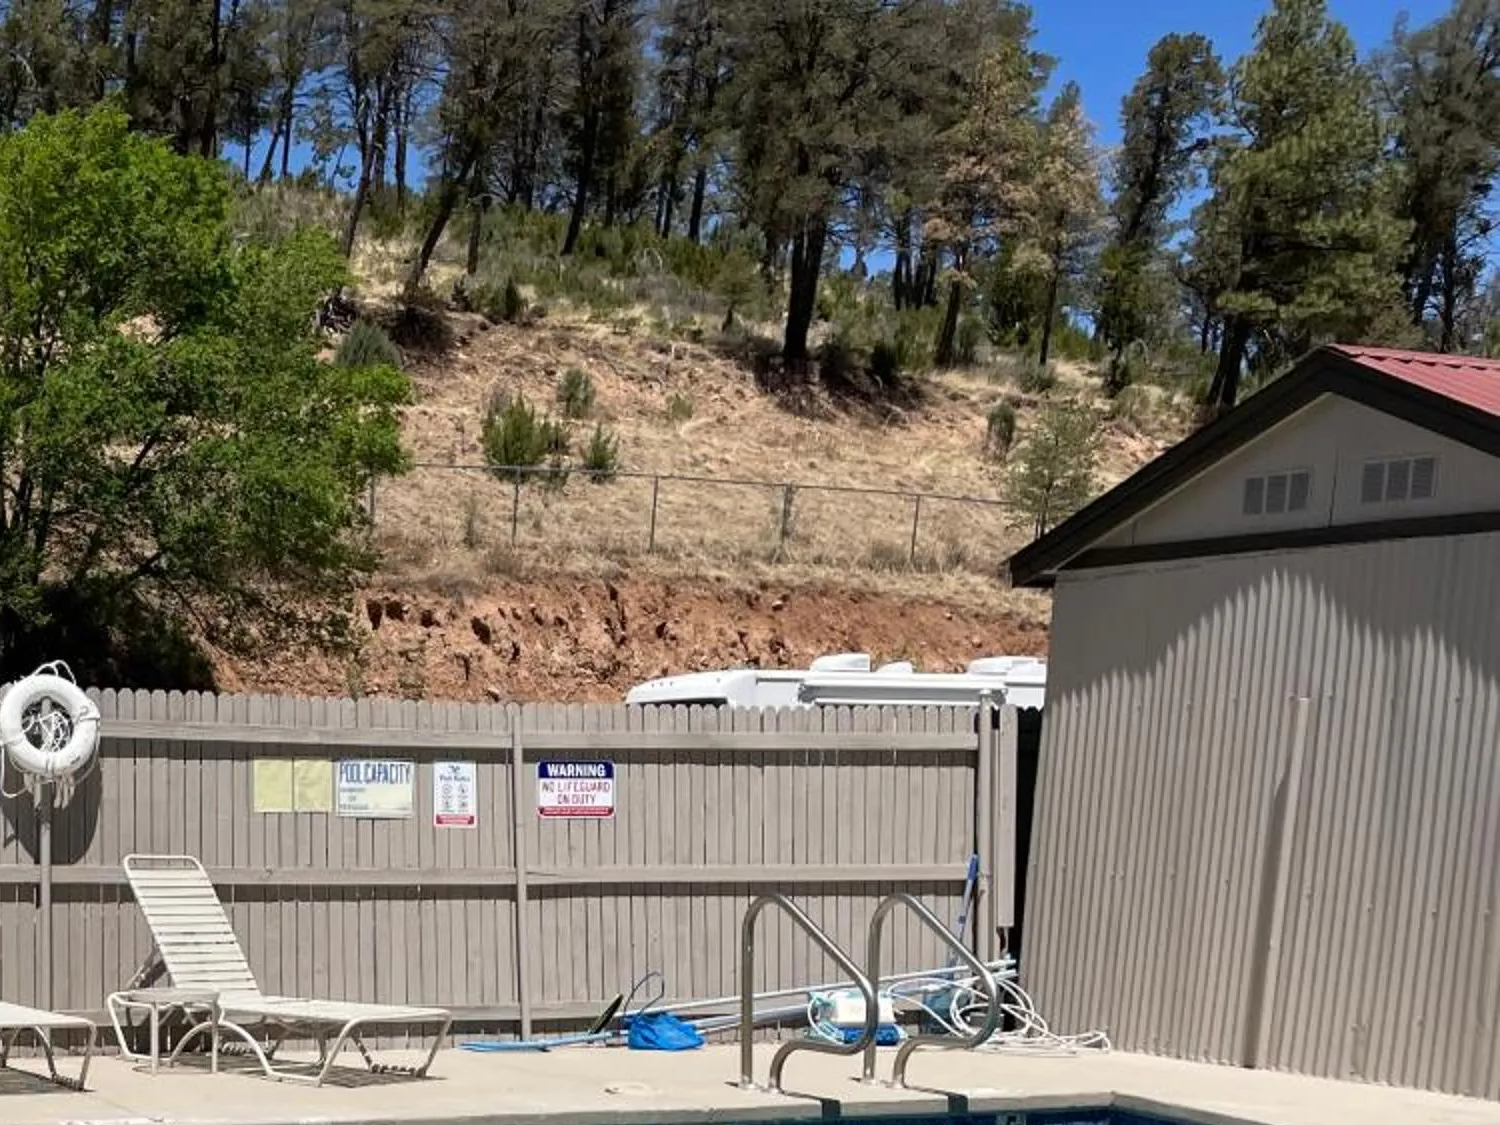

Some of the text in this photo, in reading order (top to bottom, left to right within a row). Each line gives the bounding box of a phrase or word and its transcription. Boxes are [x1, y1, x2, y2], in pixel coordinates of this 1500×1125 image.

[339, 761, 411, 785] POOL CAPACITY
[547, 763, 606, 777] WARNING
[542, 781, 611, 793] NO LIFEGUARD
[557, 793, 597, 805] ON DUTY
